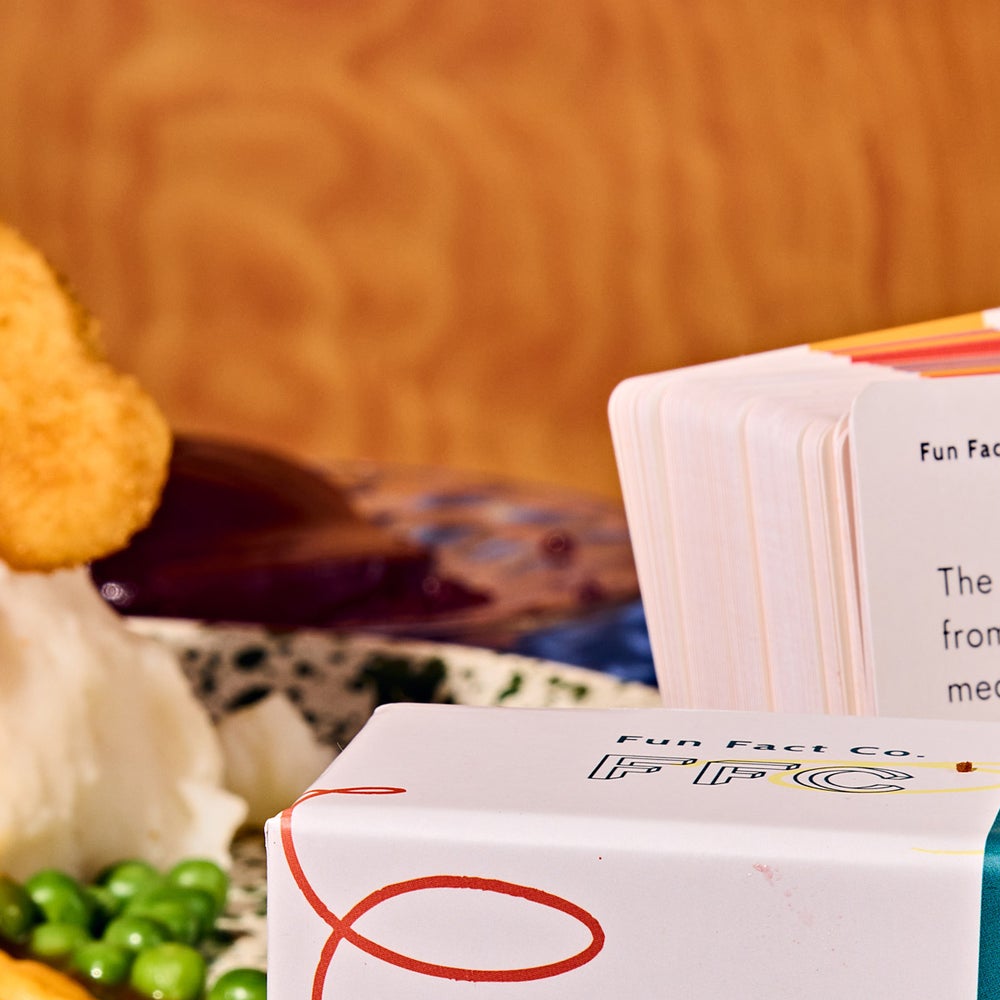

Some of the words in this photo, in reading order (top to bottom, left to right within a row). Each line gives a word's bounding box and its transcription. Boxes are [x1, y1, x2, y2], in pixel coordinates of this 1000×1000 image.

[920, 440, 958, 462] Fun
[938, 566, 993, 598] The
[616, 734, 702, 748] Fun
[725, 740, 828, 753] Fact
[849, 746, 925, 758] Co.
[587, 754, 914, 794] FFC
